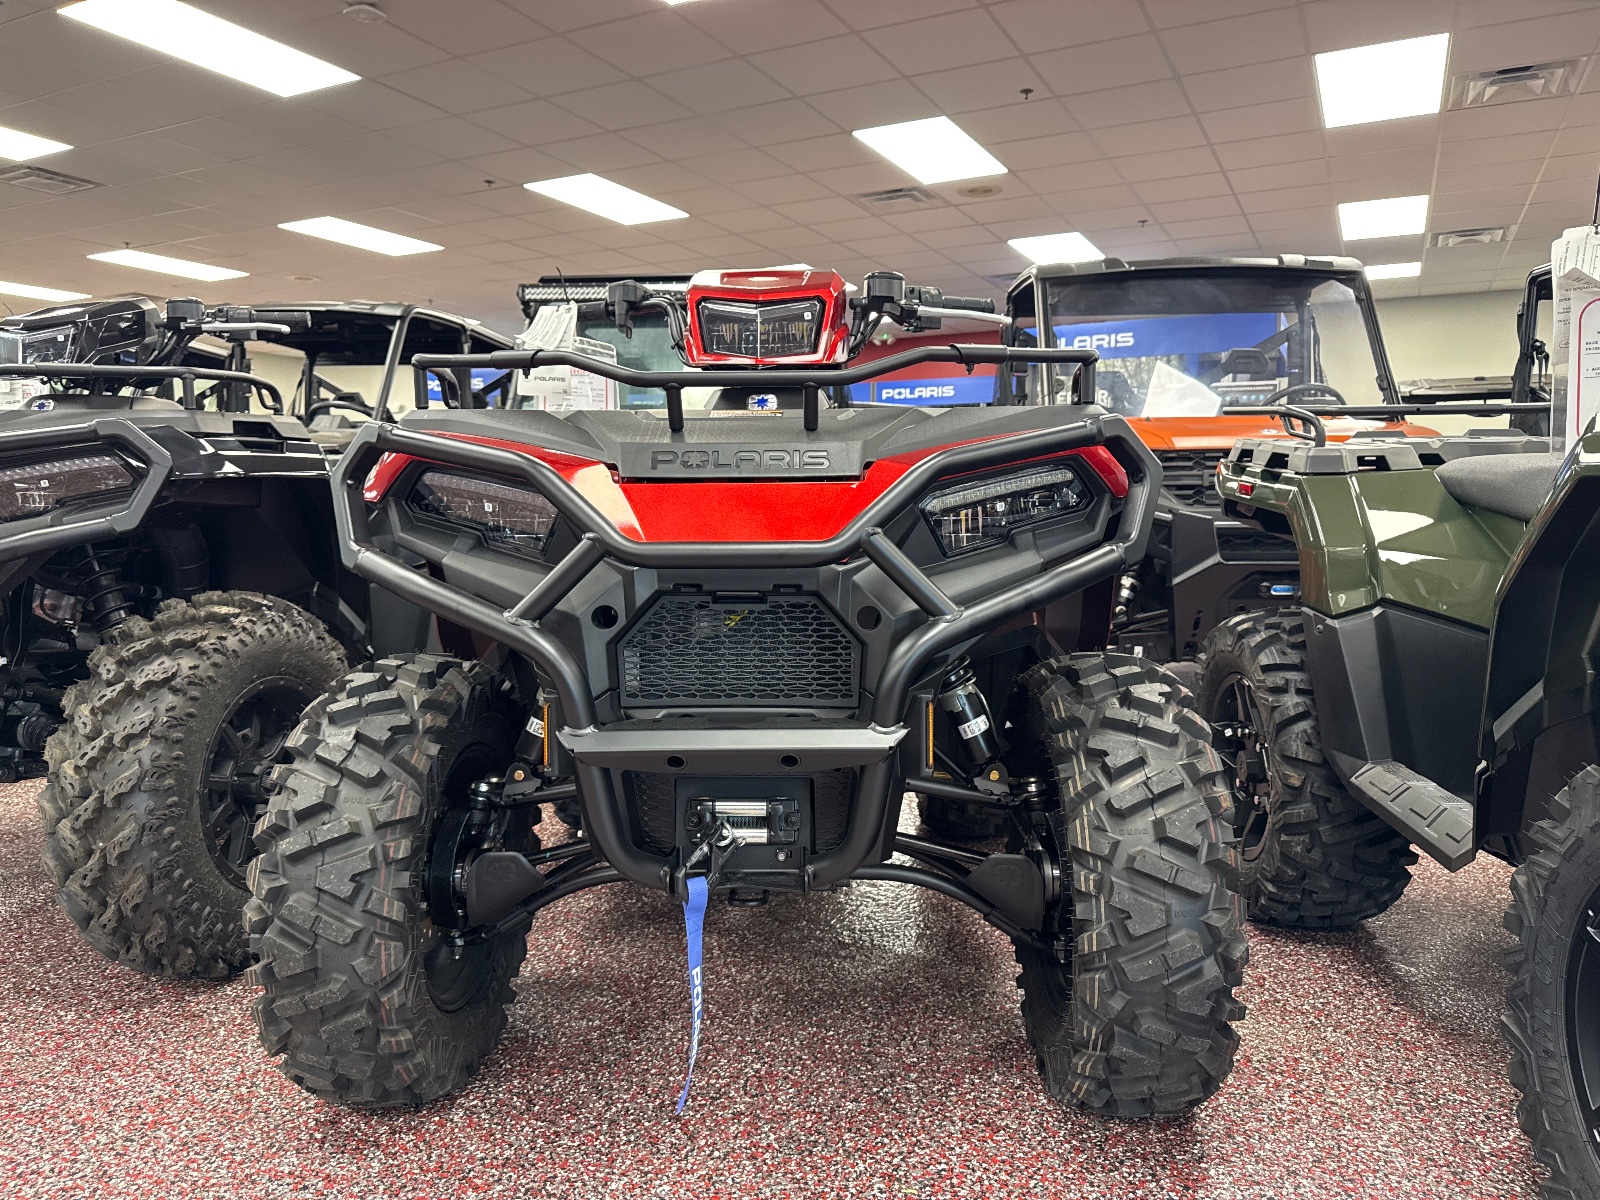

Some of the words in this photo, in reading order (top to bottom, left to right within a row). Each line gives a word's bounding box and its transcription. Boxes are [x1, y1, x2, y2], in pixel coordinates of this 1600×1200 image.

[1057, 332, 1135, 350] LARIS
[533, 375, 566, 383] POLARIS
[881, 385, 955, 401] POLARIS
[650, 450, 831, 471] POLARIS
[691, 965, 702, 1066] POLA
